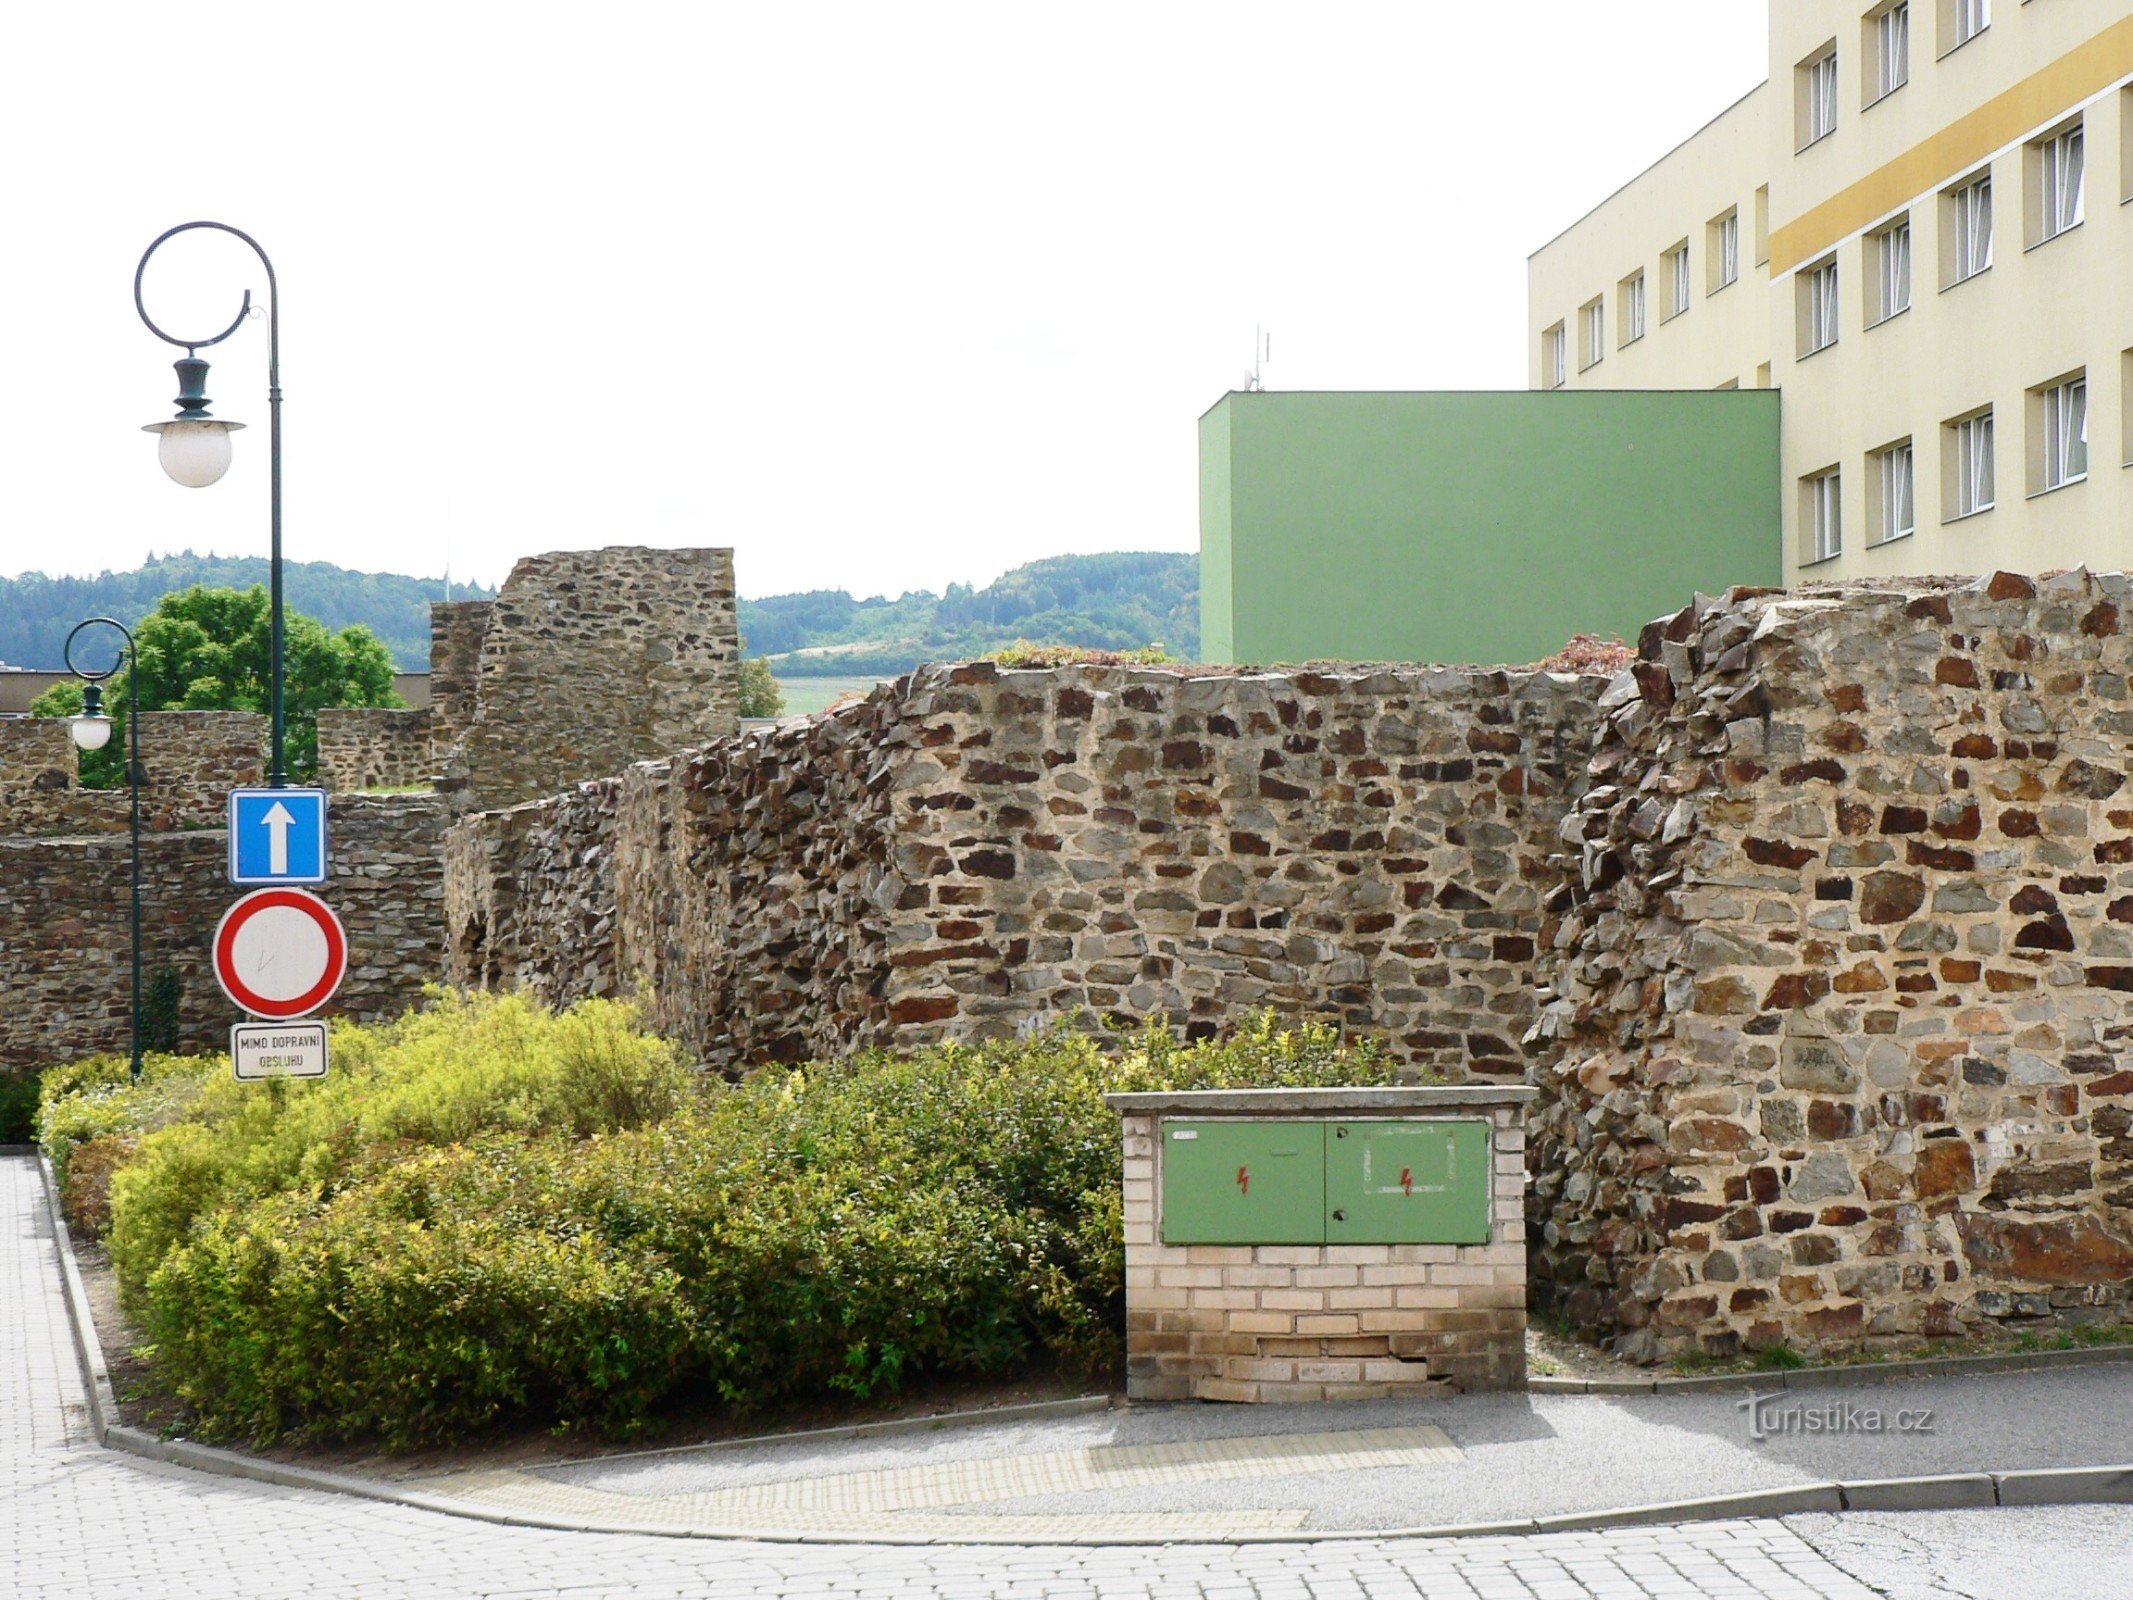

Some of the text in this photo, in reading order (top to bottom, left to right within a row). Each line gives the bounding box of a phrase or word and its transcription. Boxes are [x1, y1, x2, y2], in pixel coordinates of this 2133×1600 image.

[241, 1034, 320, 1049] MIMO DOPRAVNÍ
[260, 1055, 303, 1067] OBSLUHU
